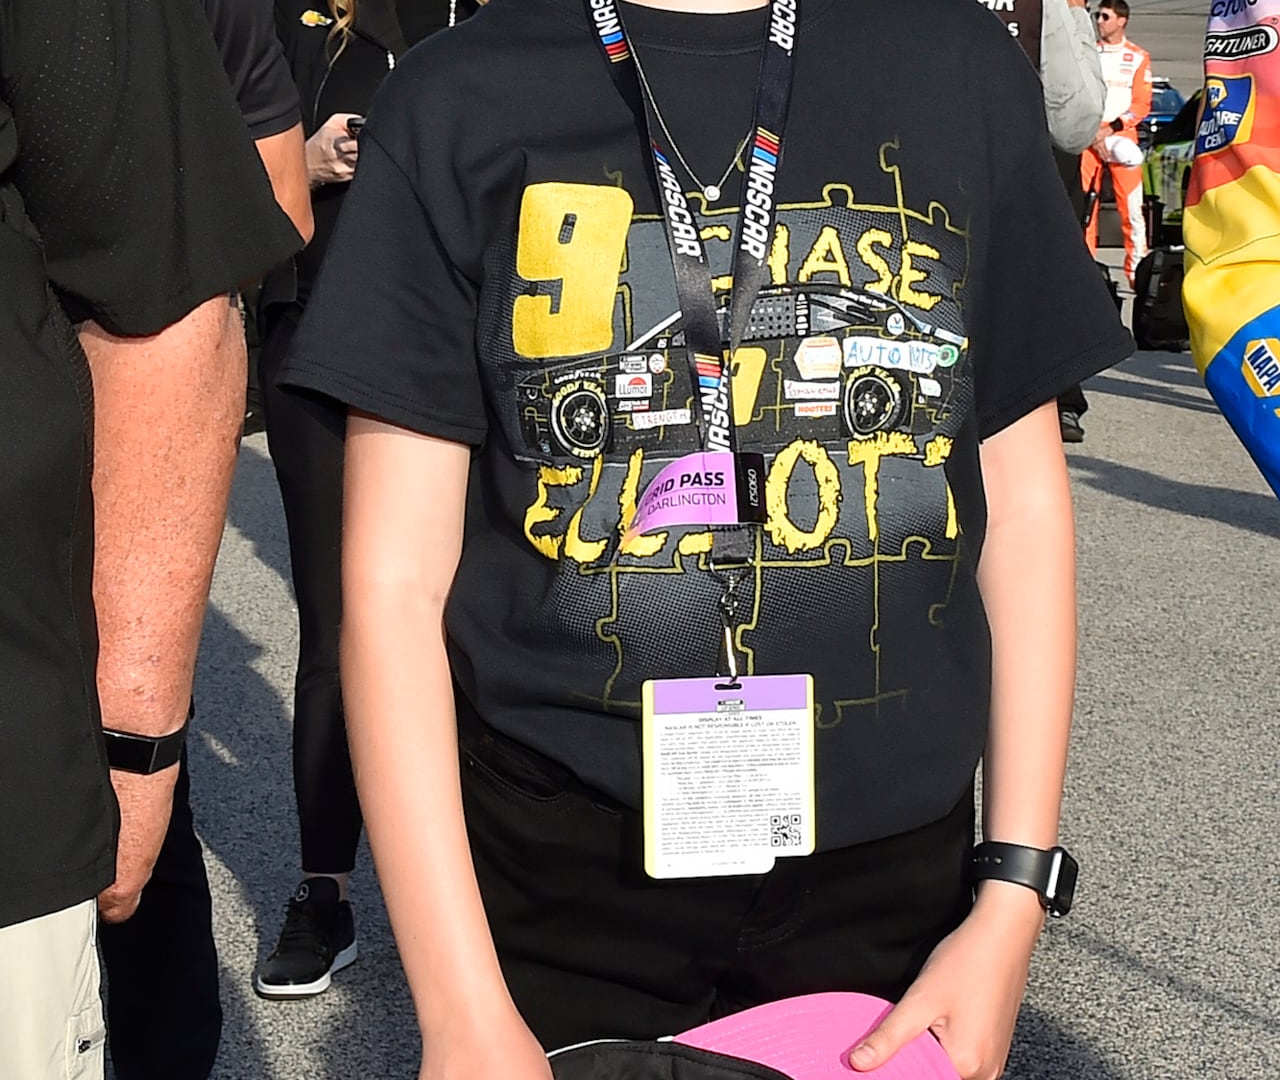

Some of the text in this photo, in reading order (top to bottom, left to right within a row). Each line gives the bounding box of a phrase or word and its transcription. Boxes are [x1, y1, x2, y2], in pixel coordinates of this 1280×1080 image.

[1205, 33, 1266, 53] GHTLINER
[656, 157, 702, 258] NASCAR
[740, 157, 777, 264] NASCAR
[513, 182, 634, 358] 9
[648, 493, 726, 515] DARLINGTON
[680, 472, 724, 488] PASS
